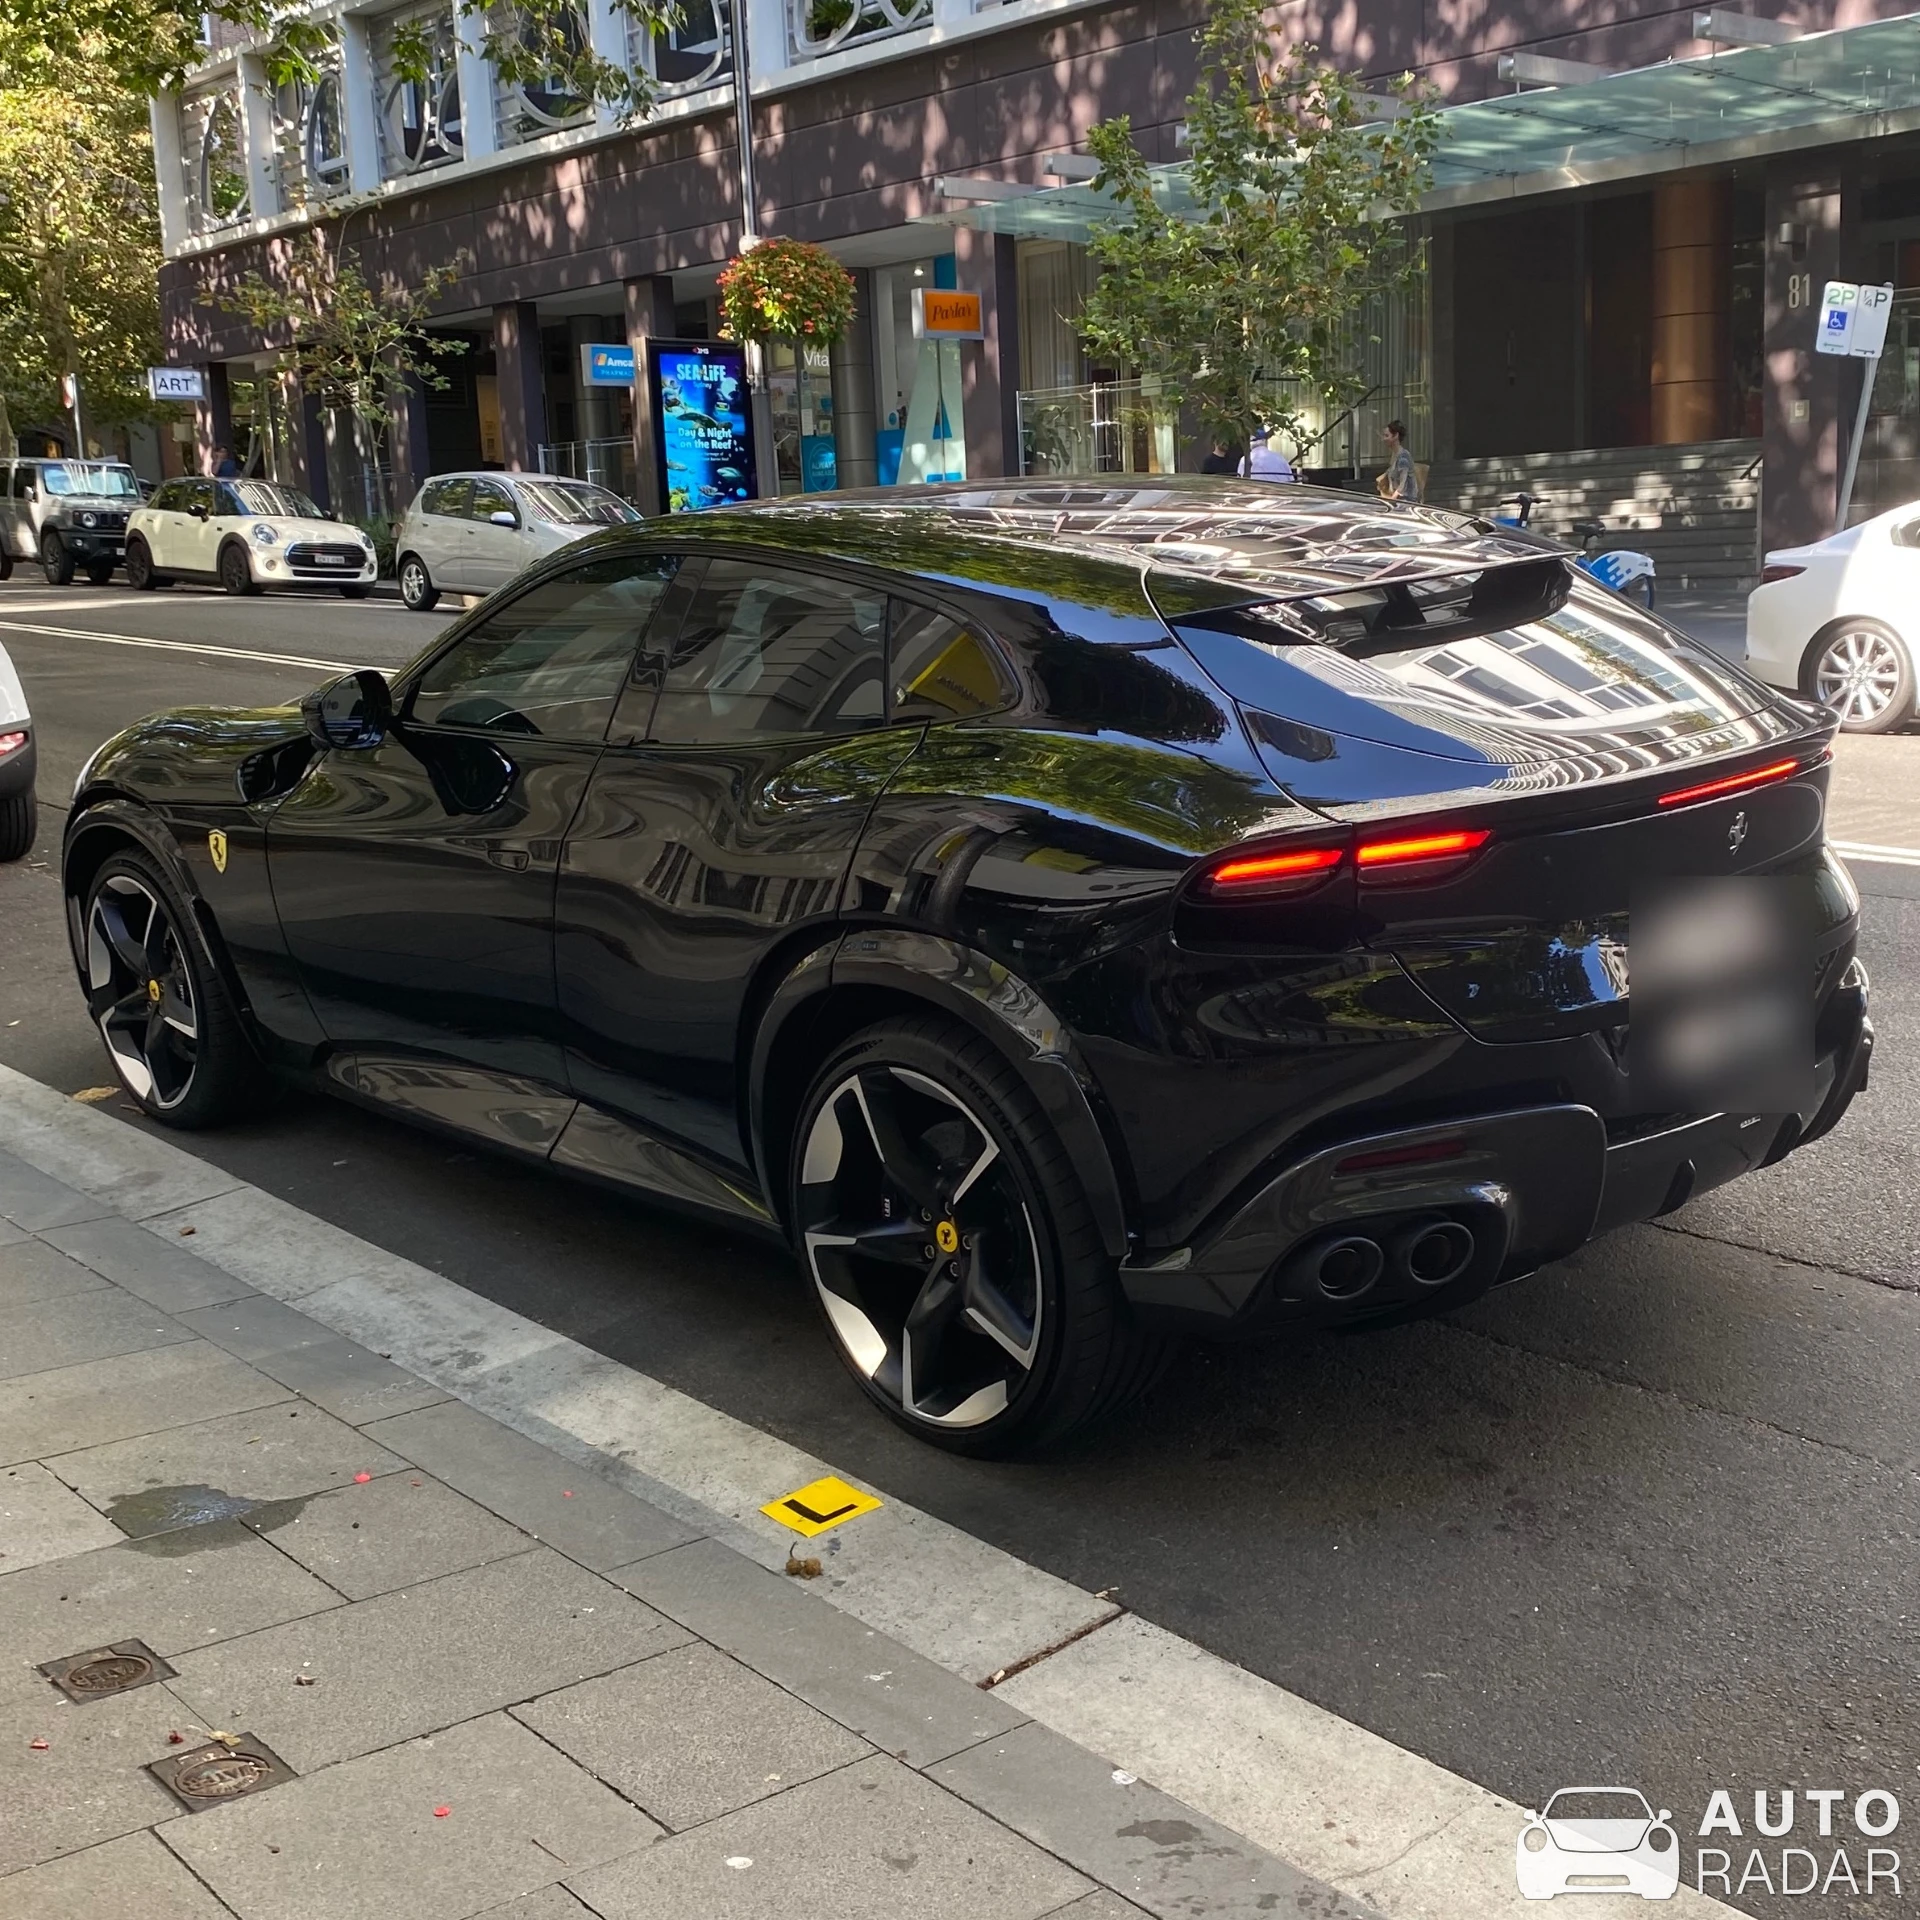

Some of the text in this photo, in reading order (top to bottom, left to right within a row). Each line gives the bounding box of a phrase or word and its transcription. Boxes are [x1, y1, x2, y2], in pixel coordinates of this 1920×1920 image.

[1788, 273, 1811, 309] 81
[1827, 287, 1855, 306] 2P
[931, 301, 972, 323] Parlar
[607, 357, 635, 367] Amca
[803, 350, 830, 367] Vita
[600, 369, 635, 377] PHARMAC
[678, 427, 732, 440] Day & Night
[693, 439, 710, 449] the
[711, 439, 732, 449] Reef
[782, 1498, 859, 1524] L
